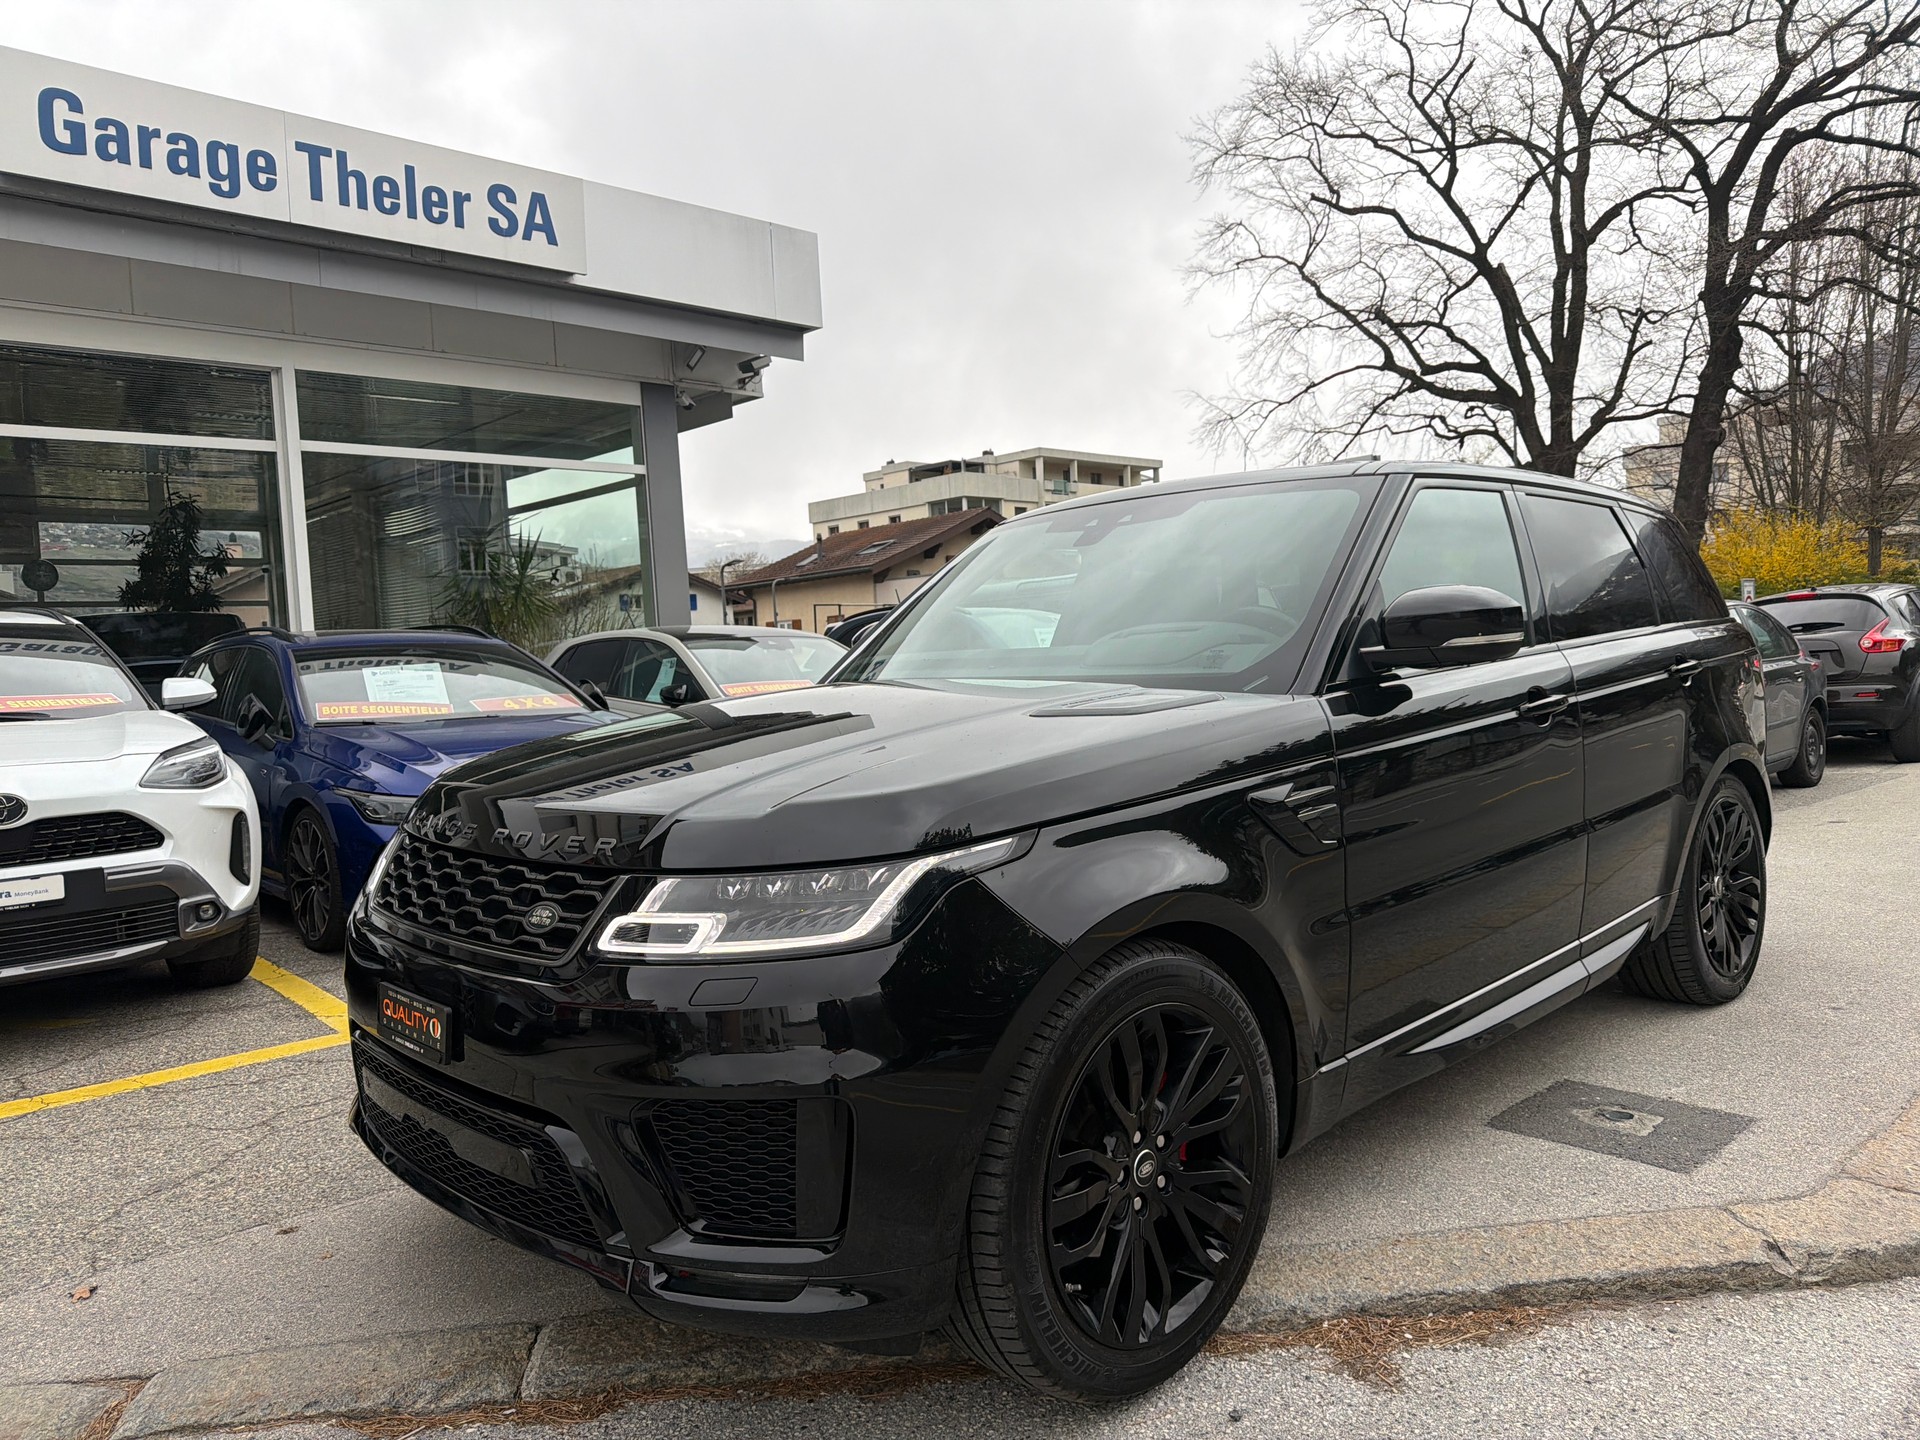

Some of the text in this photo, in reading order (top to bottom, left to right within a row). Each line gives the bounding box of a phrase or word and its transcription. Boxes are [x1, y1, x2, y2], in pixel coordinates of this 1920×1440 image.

[37, 87, 558, 246] Garage Theler SA
[728, 686, 753, 695] BOITE
[6, 697, 118, 708] SEQUENTIELLE
[322, 705, 448, 715] BOITE SEQUENTIELLE
[413, 811, 617, 856] RANGE ROVER
[14, 888, 49, 897] MoneyBank
[531, 916, 551, 926] ROVER
[533, 909, 549, 917] LAND
[383, 999, 429, 1032] QUALITY
[383, 1018, 440, 1049] GARANTIE
[1218, 986, 1271, 1076] MICHELIN
[1029, 1290, 1100, 1381] MICHELIN
